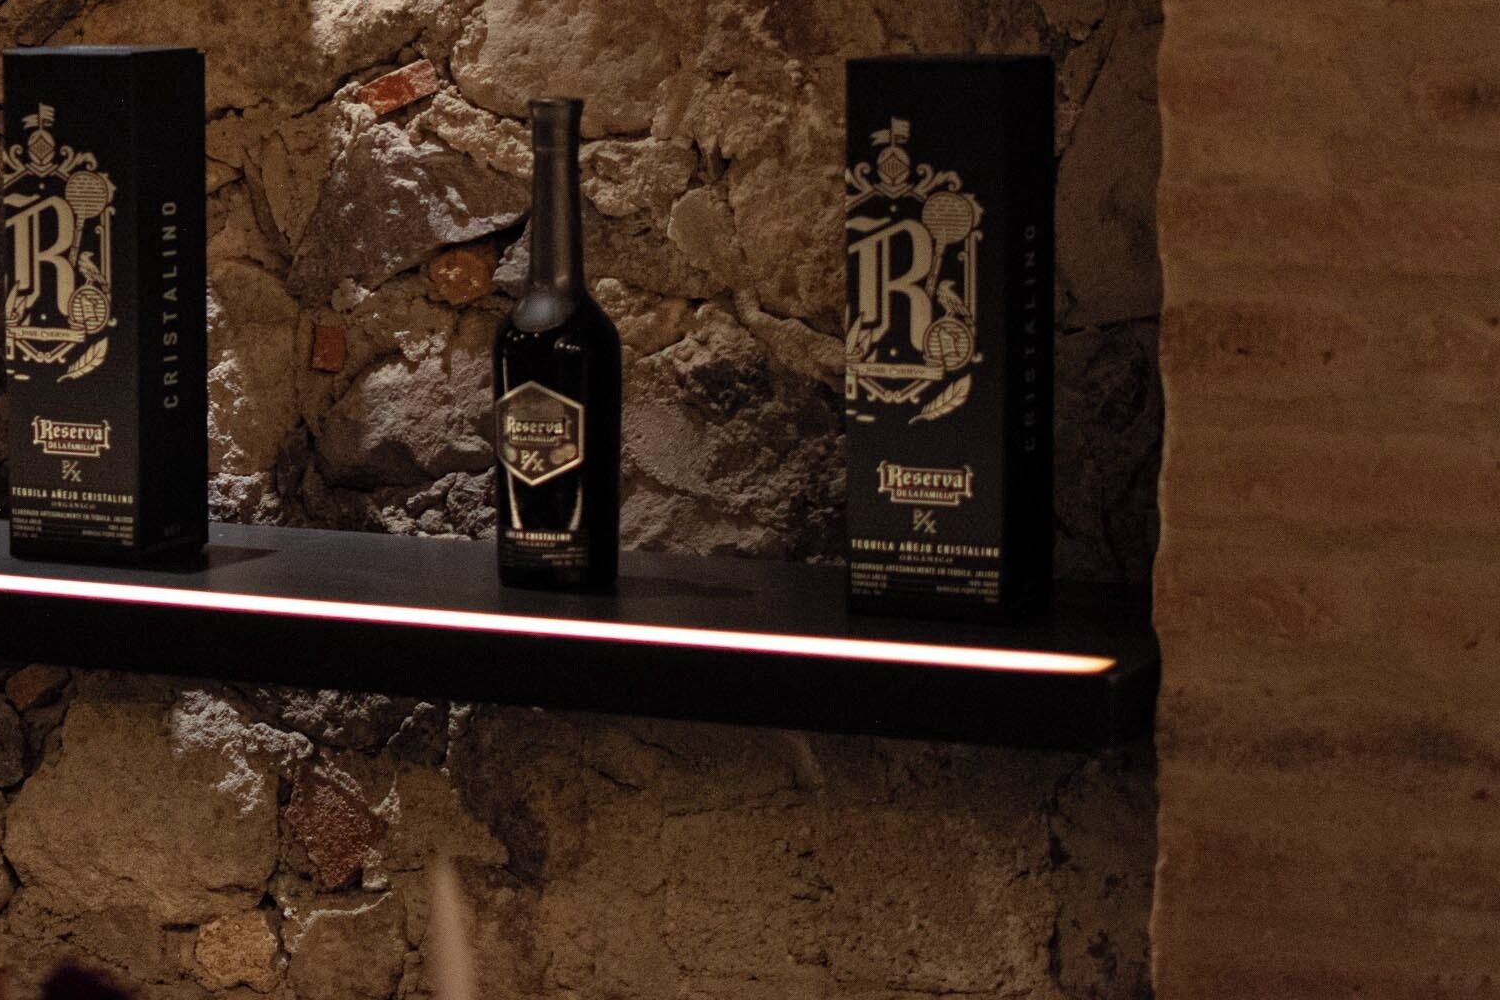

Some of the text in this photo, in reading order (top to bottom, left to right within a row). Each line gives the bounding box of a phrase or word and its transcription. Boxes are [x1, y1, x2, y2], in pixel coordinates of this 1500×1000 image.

[162, 201, 179, 409] CRISTALINO
[40, 420, 103, 441] Reserva
[504, 416, 563, 434] Reserva
[886, 464, 963, 488] Reserva
[12, 486, 133, 504] TEQUILA AÑEJO CRISTALINO
[852, 539, 999, 558] TEQUILA AÑEJO CRISTALINO
